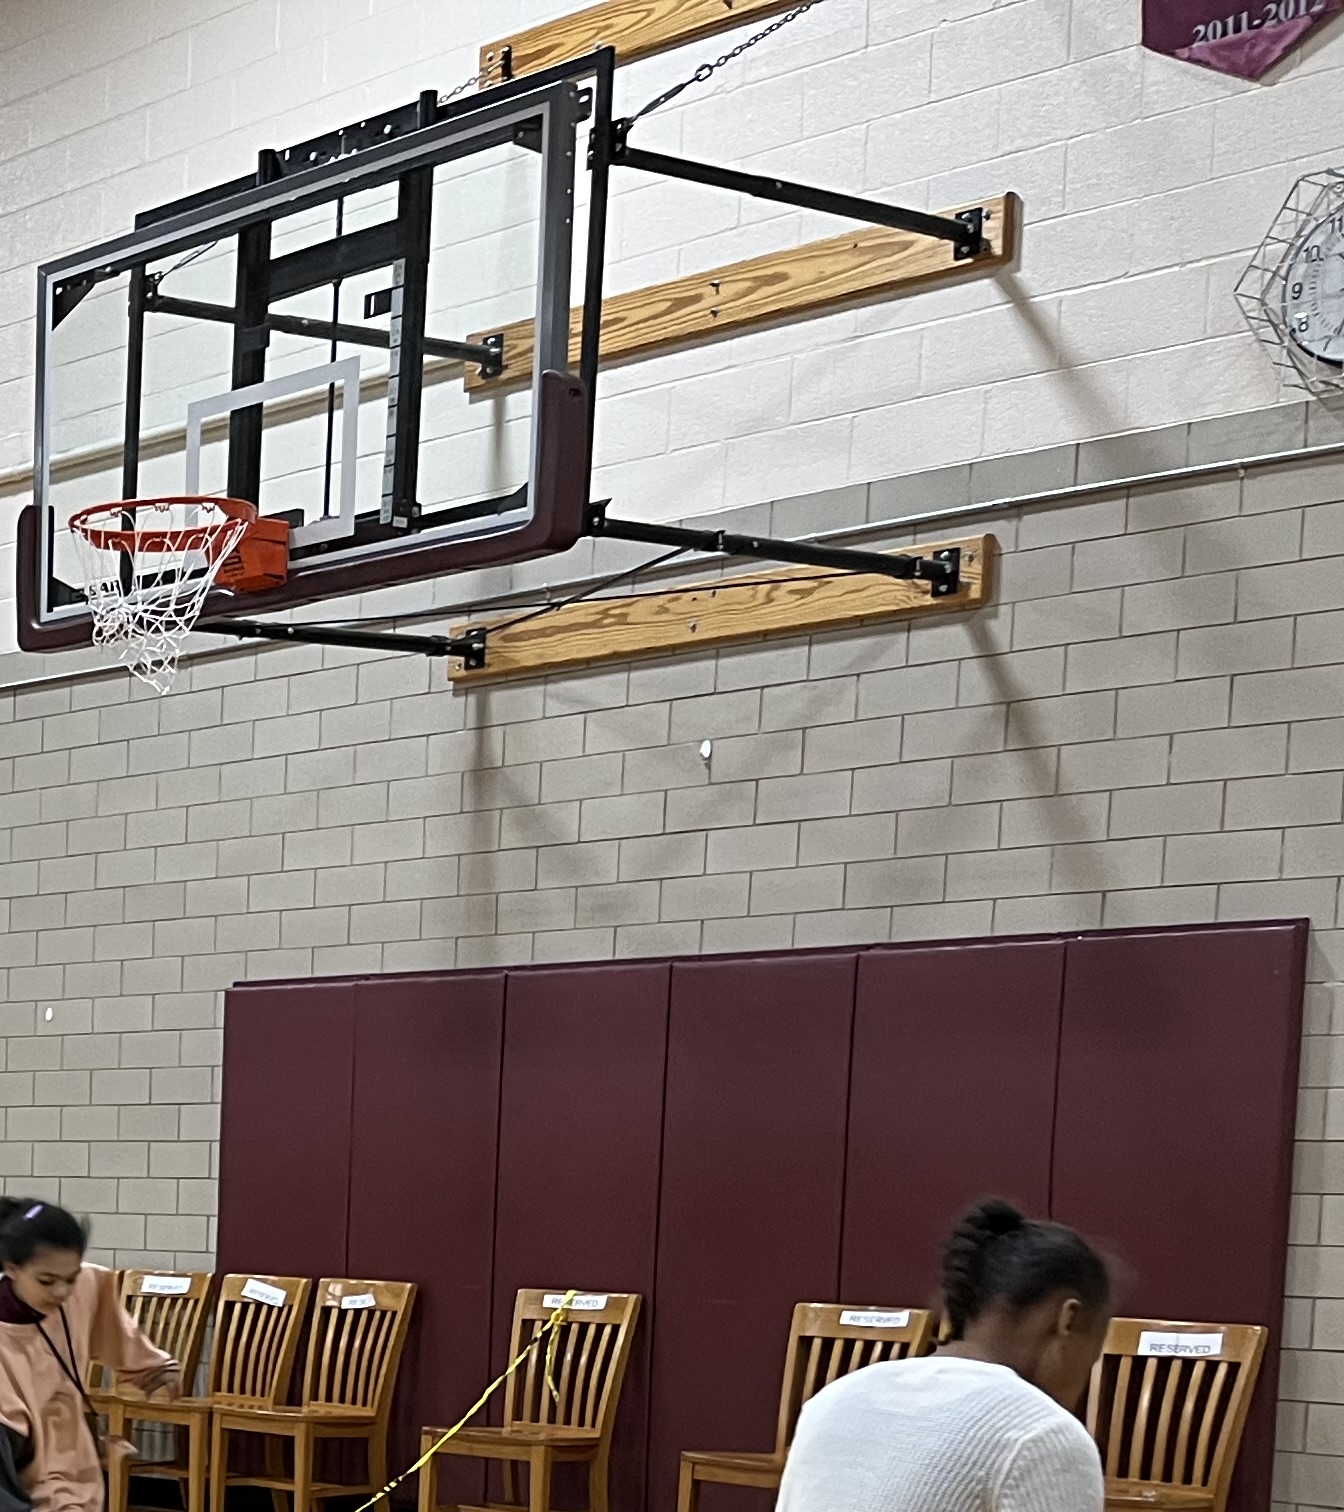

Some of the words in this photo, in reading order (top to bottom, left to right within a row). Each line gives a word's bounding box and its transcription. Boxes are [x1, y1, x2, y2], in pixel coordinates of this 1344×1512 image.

[1291, 282, 1303, 300] 9
[551, 1297, 599, 1308] REERVED
[849, 1314, 902, 1325] RESERVED
[1149, 1343, 1212, 1354] RESERVED
